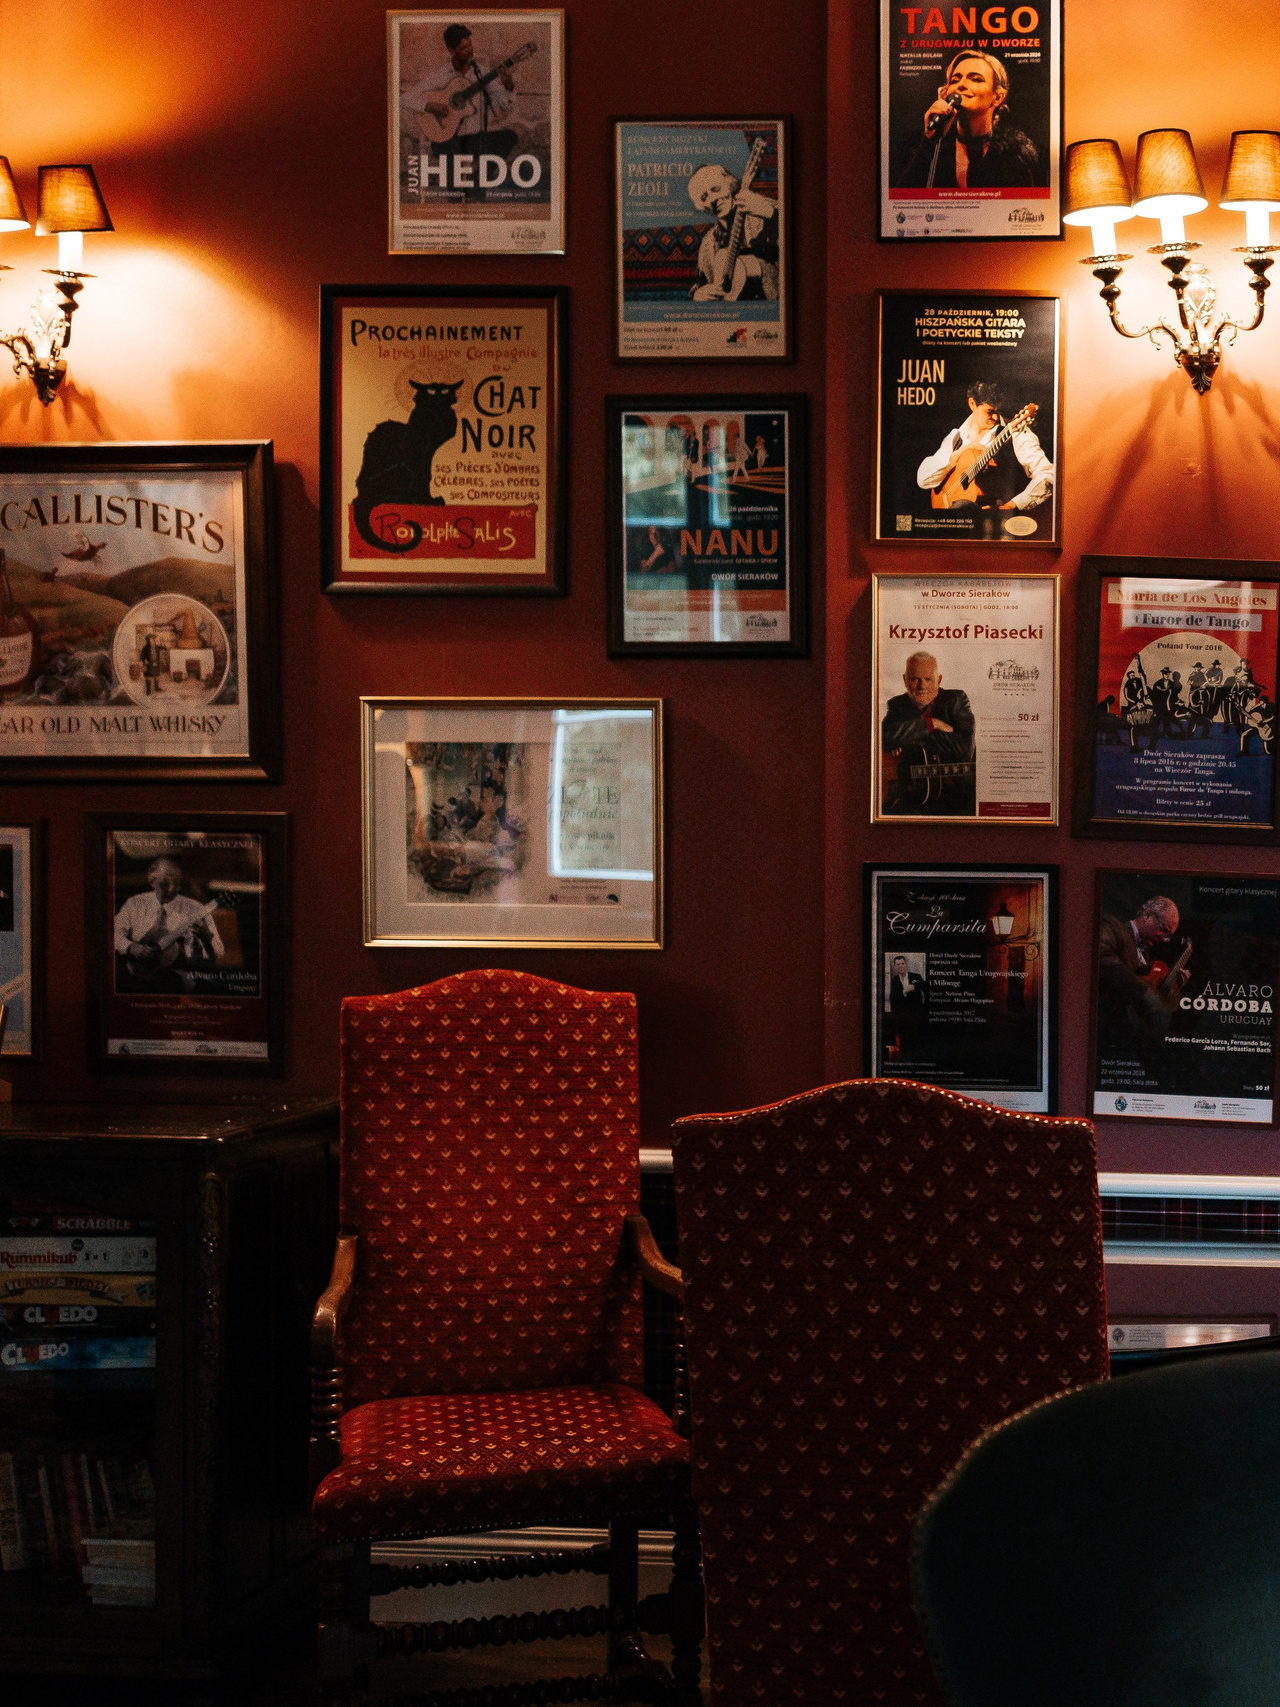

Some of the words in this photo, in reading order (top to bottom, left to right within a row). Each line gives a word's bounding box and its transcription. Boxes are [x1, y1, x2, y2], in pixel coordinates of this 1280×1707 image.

[900, 6, 1039, 34] TANGO
[912, 40, 974, 48] URUGWAJU
[992, 38, 1040, 47] DWORZE
[408, 155, 418, 194] JUAN
[420, 154, 541, 188] HEDO
[628, 162, 693, 177] PATRICIO
[628, 182, 669, 196] ZEOLI
[915, 316, 983, 327] HISZPAŃSKA
[986, 318, 1026, 328] GITARA
[350, 319, 522, 346] PROCHAINEMENT
[923, 328, 982, 338] POETYCKIE
[984, 329, 1024, 338] TEKSTY
[897, 359, 944, 383] JUAN
[473, 376, 541, 417] CHAT
[898, 387, 936, 406] HEDO
[462, 418, 536, 453] NOIR
[680, 529, 778, 556] NANU
[712, 572, 736, 581] DWÓR
[738, 572, 778, 580] SIERAKÓW
[932, 590, 966, 598] Dworze
[968, 589, 1010, 598] Sieraków
[1162, 592, 1179, 603] de
[1183, 593, 1207, 604] Los
[1142, 613, 1182, 625] Furor
[1186, 614, 1203, 626] de
[1206, 616, 1250, 630] Tango
[890, 624, 970, 642] Krzysztof
[974, 625, 1043, 639] Piasecki
[1031, 713, 1039, 721] zł
[41, 716, 80, 734] OLD
[91, 715, 144, 734] MALT
[150, 715, 226, 737] WHISKY
[1140, 758, 1156, 766] lipca
[1188, 760, 1216, 768] godzinie
[1164, 750, 1194, 758] Sieraków
[1196, 753, 1225, 761] zaprasza
[1165, 766, 1192, 774] Wieczór
[1194, 768, 1216, 776] Tanga.
[886, 911, 987, 939] Cumparsita
[958, 969, 978, 978] Tanga
[979, 970, 1029, 979] Urugwajskiego
[1202, 981, 1273, 998] ÁLVARO
[1180, 995, 1272, 1014] CÓRDOBA
[1220, 1016, 1272, 1025] URUGUAY
[1, 1342, 68, 1366] CLUEDO
